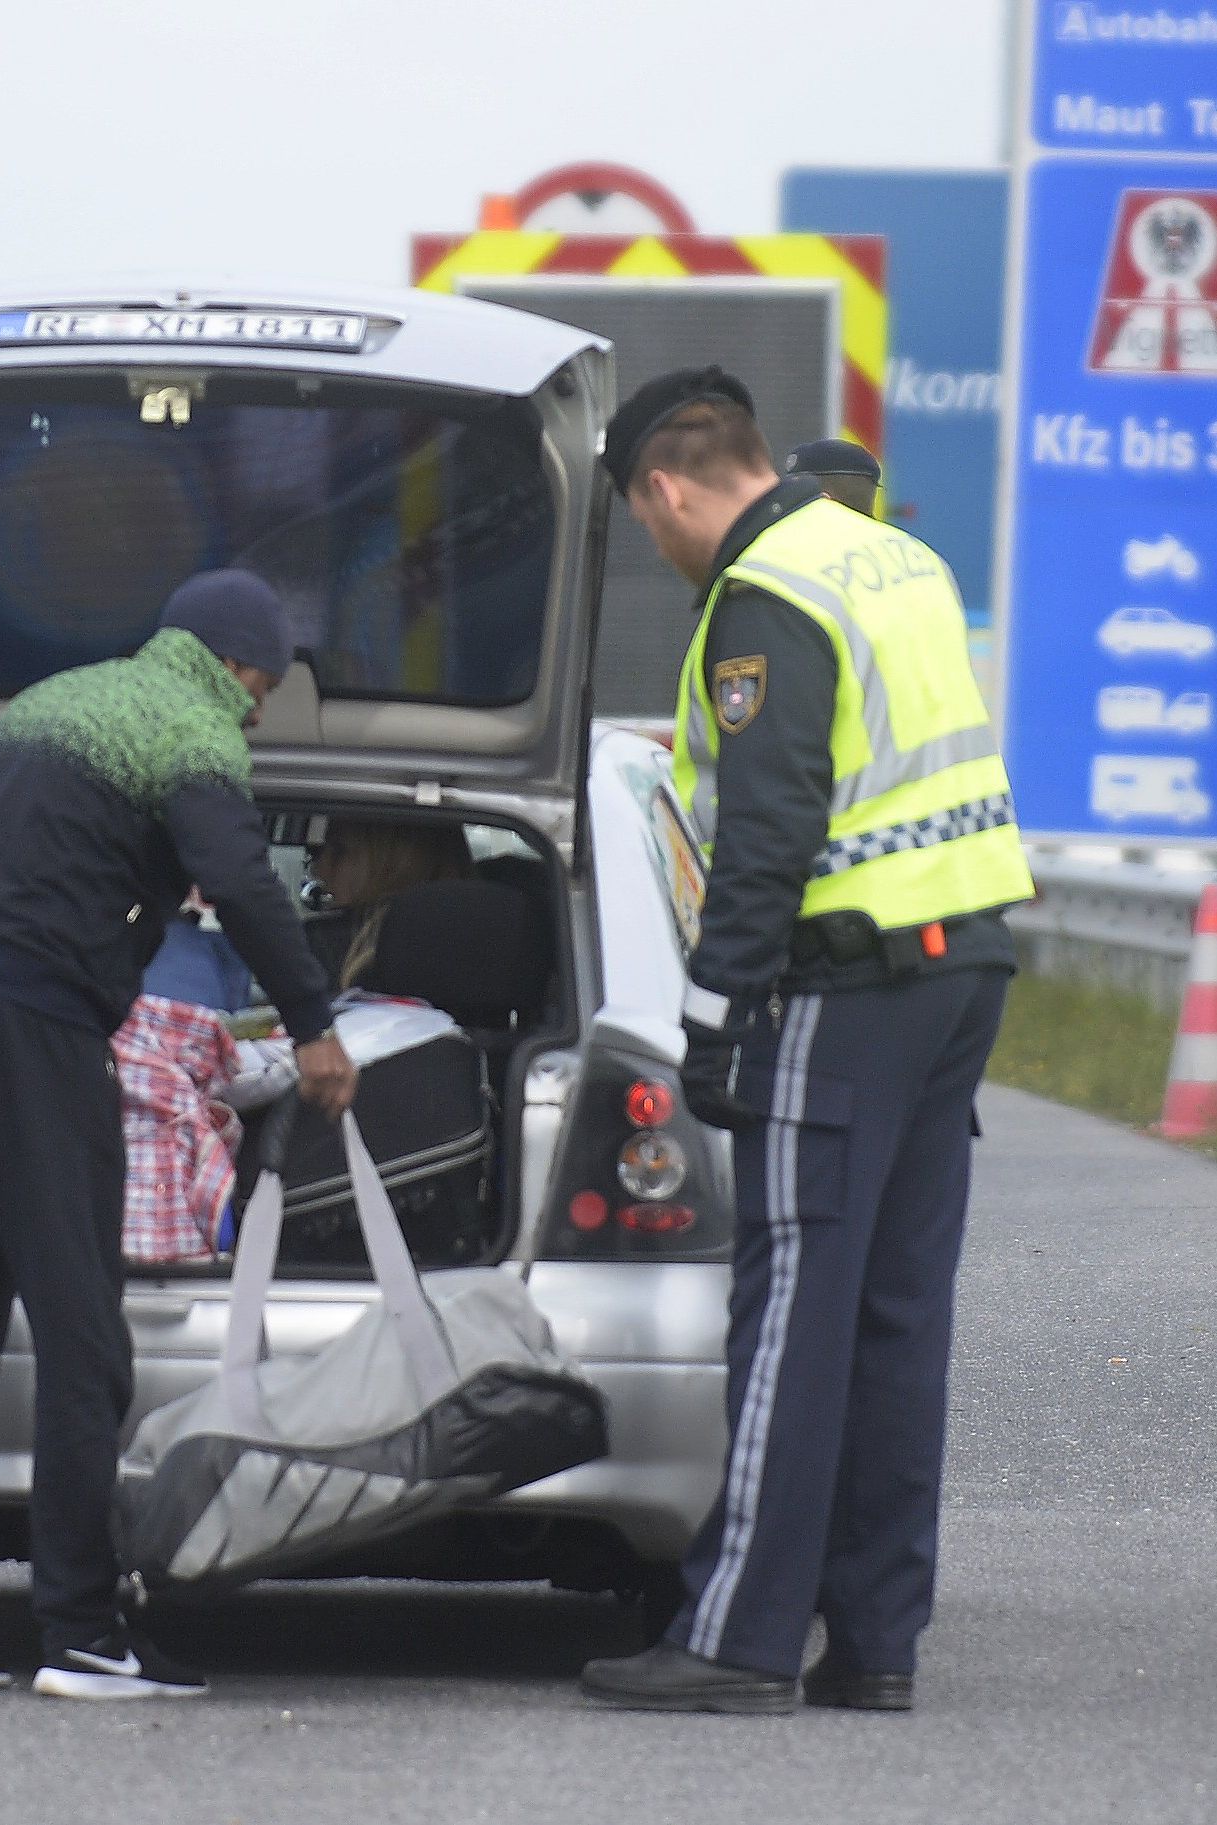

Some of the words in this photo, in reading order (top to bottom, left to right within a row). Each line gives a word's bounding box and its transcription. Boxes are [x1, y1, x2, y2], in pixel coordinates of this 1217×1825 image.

[1055, 95, 1164, 134] Maut
[231, 316, 347, 338] 1811
[1036, 414, 1109, 466] Kfz
[1122, 416, 1196, 468] bis
